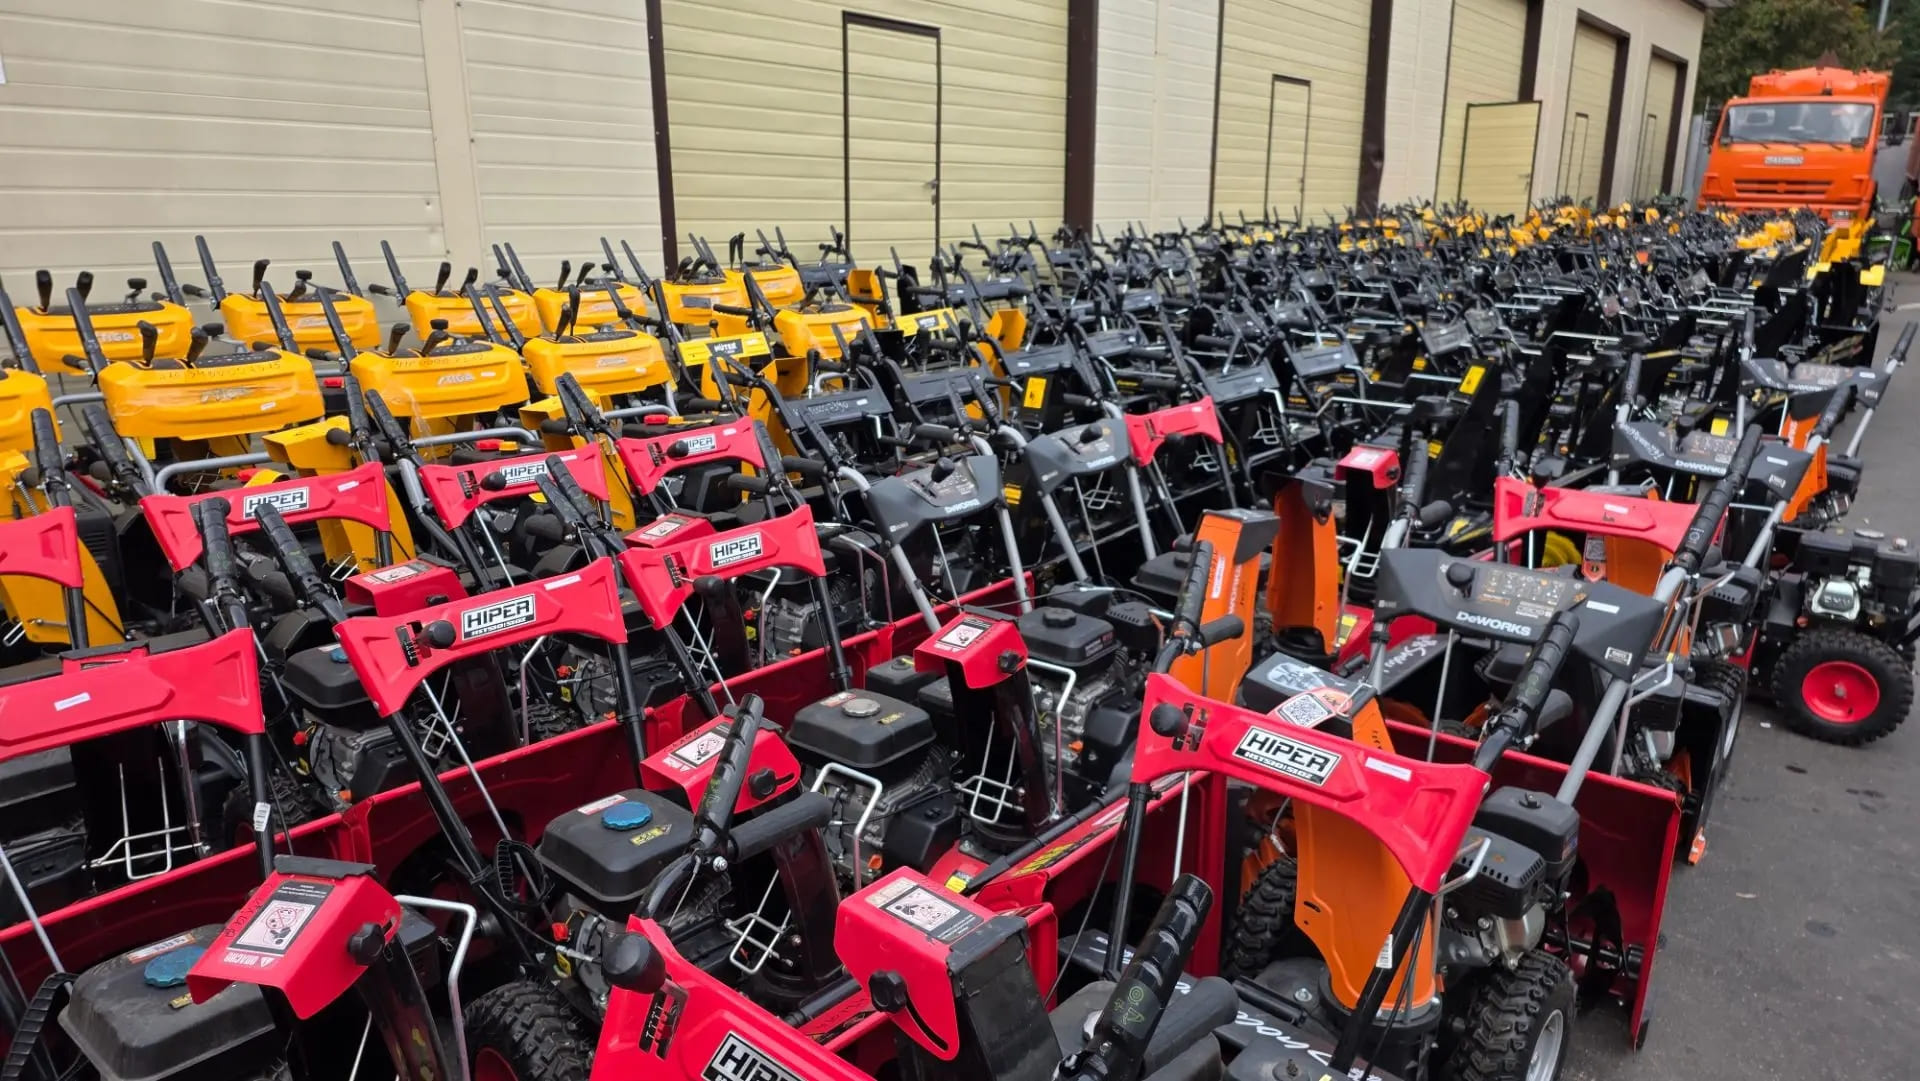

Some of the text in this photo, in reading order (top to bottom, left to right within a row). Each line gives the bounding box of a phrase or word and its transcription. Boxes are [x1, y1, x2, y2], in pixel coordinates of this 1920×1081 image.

[687, 437, 713, 449] IPER
[504, 464, 545, 478] HIPER
[714, 537, 758, 558] HIPER
[467, 599, 530, 629] HIPER
[1456, 610, 1532, 637] DeWORKS
[1246, 732, 1331, 772] HIPER
